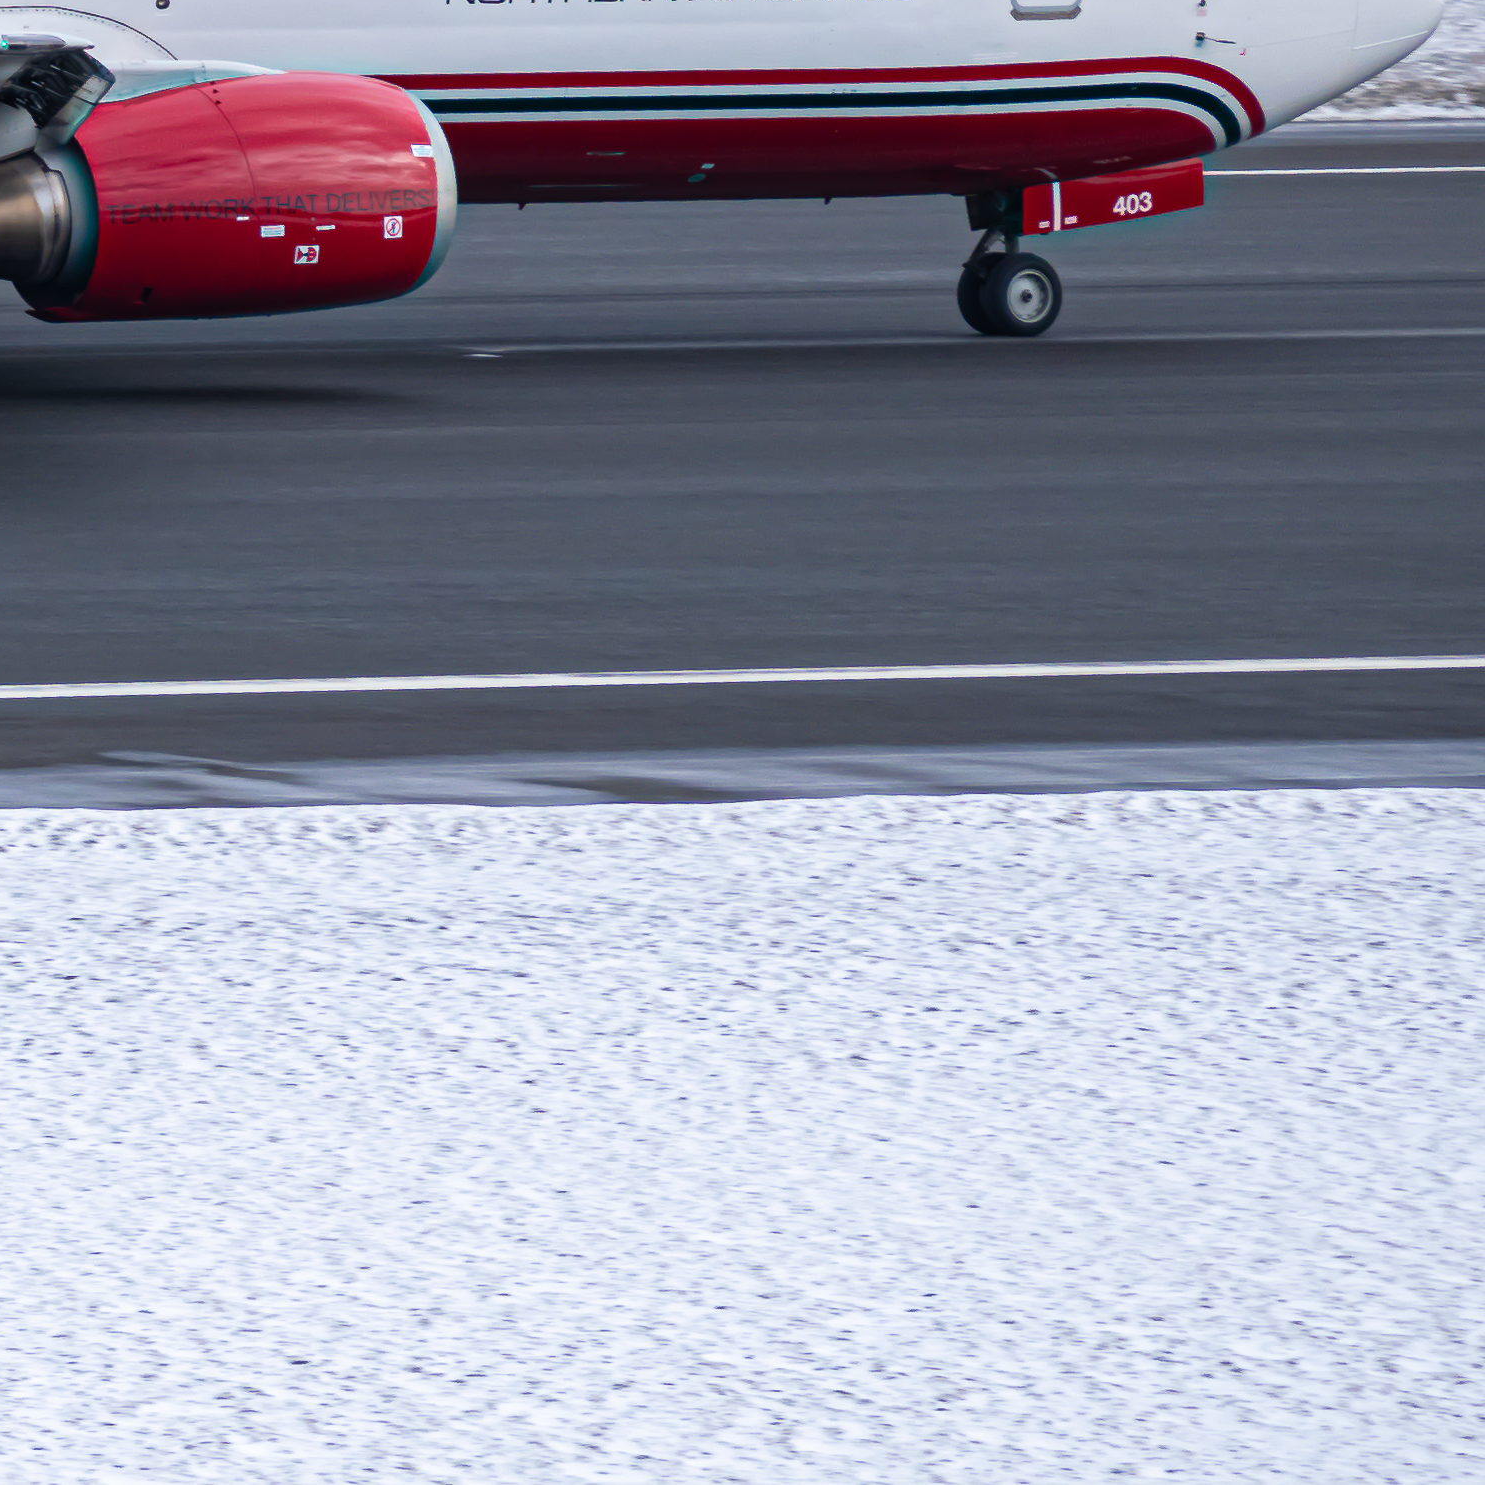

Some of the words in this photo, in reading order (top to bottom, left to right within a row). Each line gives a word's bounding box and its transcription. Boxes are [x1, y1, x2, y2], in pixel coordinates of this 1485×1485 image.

[105, 202, 175, 225] TEAM
[180, 197, 256, 222] WORK
[260, 193, 319, 215] THAT
[325, 187, 436, 213] DELIVERS!
[1112, 191, 1154, 217] 403
